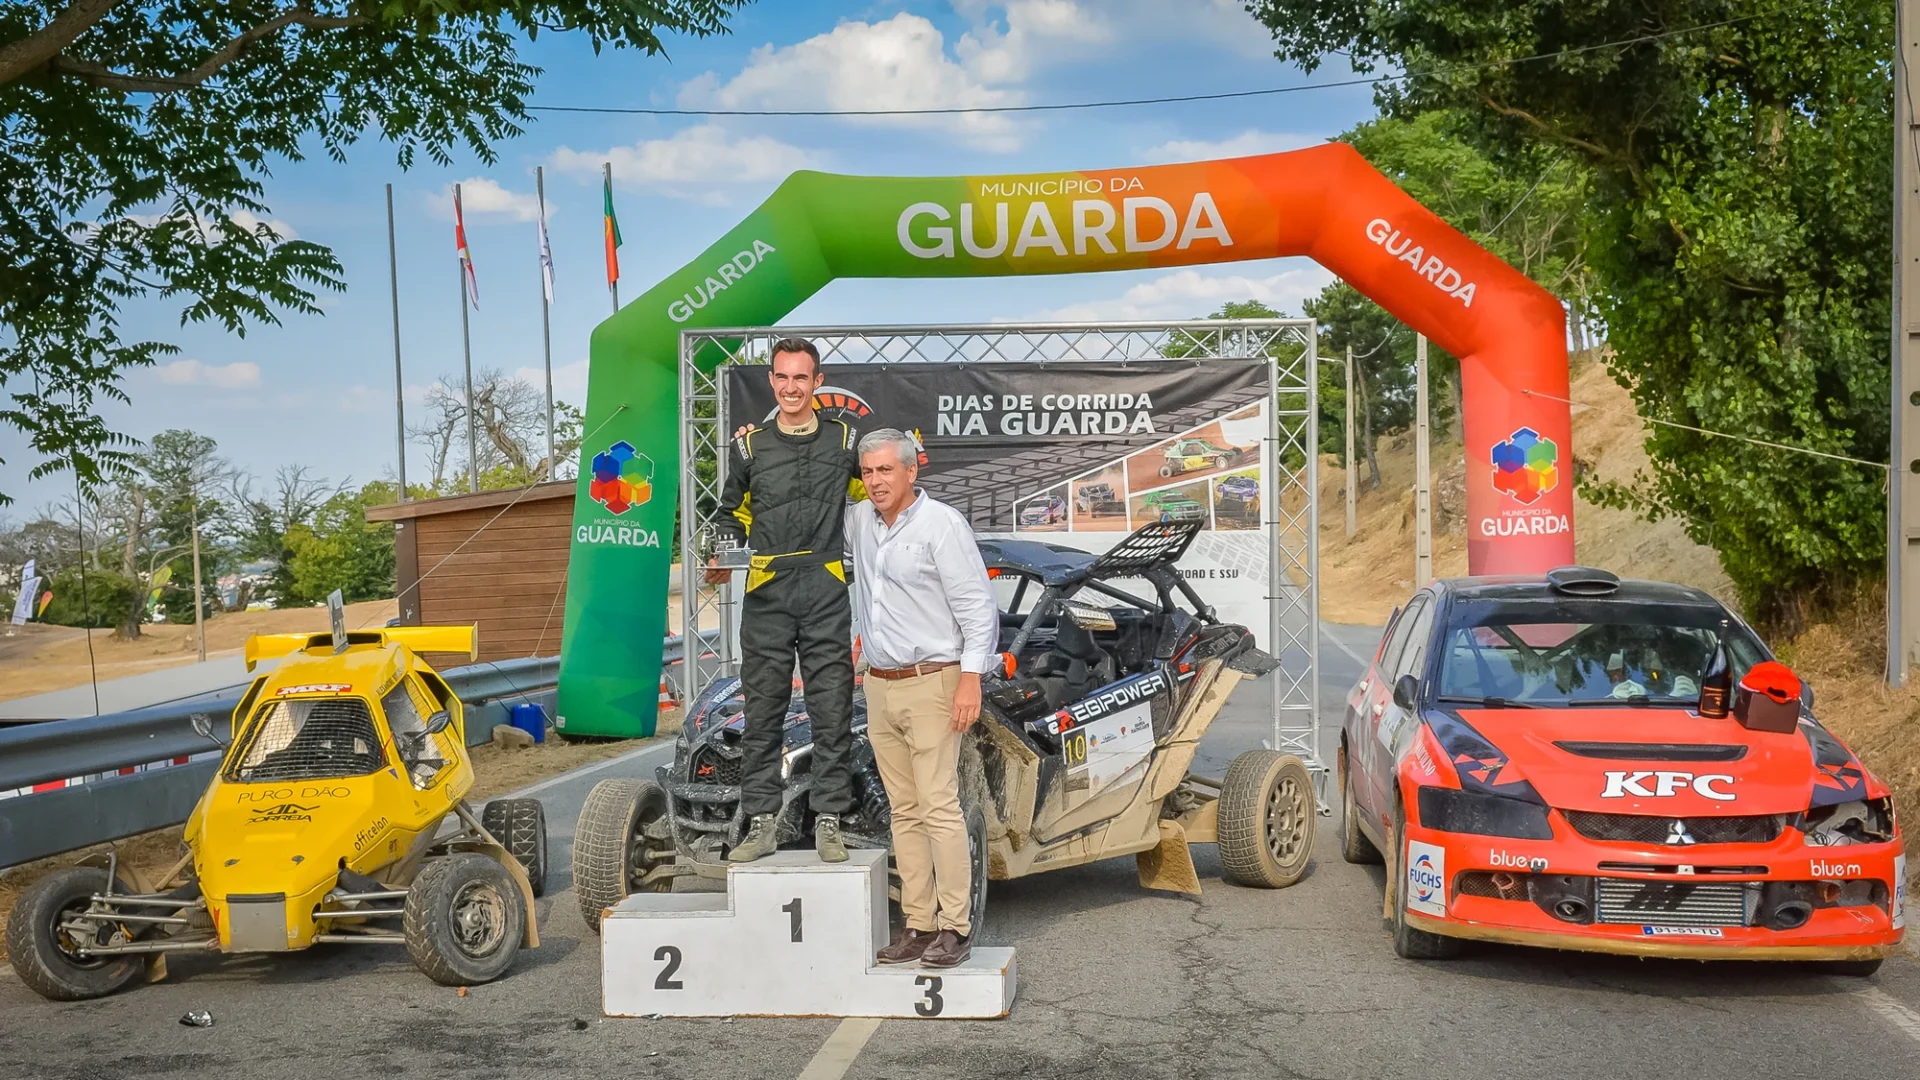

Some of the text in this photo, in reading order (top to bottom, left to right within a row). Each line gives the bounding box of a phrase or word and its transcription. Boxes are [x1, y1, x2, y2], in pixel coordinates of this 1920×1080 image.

[981, 176, 1144, 197] MUNICÍPIO DA
[897, 192, 1234, 259] GUARDA
[1365, 218, 1477, 308] GUARDA
[667, 239, 776, 323] GUARDA
[938, 393, 1153, 411] DIAS DE CORRIDA
[937, 411, 1156, 436] NA GUARDA
[1542, 508, 1552, 516] DA
[576, 525, 660, 548] GUARDA
[1481, 514, 1570, 537] GUARDA
[1210, 569, 1215, 579] E
[277, 684, 351, 695] MRF
[1065, 735, 1085, 763] 10
[237, 787, 351, 804] PURO DÃO
[1600, 770, 1737, 801] KFC
[354, 816, 389, 851] officelan
[1410, 868, 1442, 889] FUCHS
[782, 898, 804, 943] 1
[653, 945, 683, 990] 2
[914, 975, 944, 1017] 3
